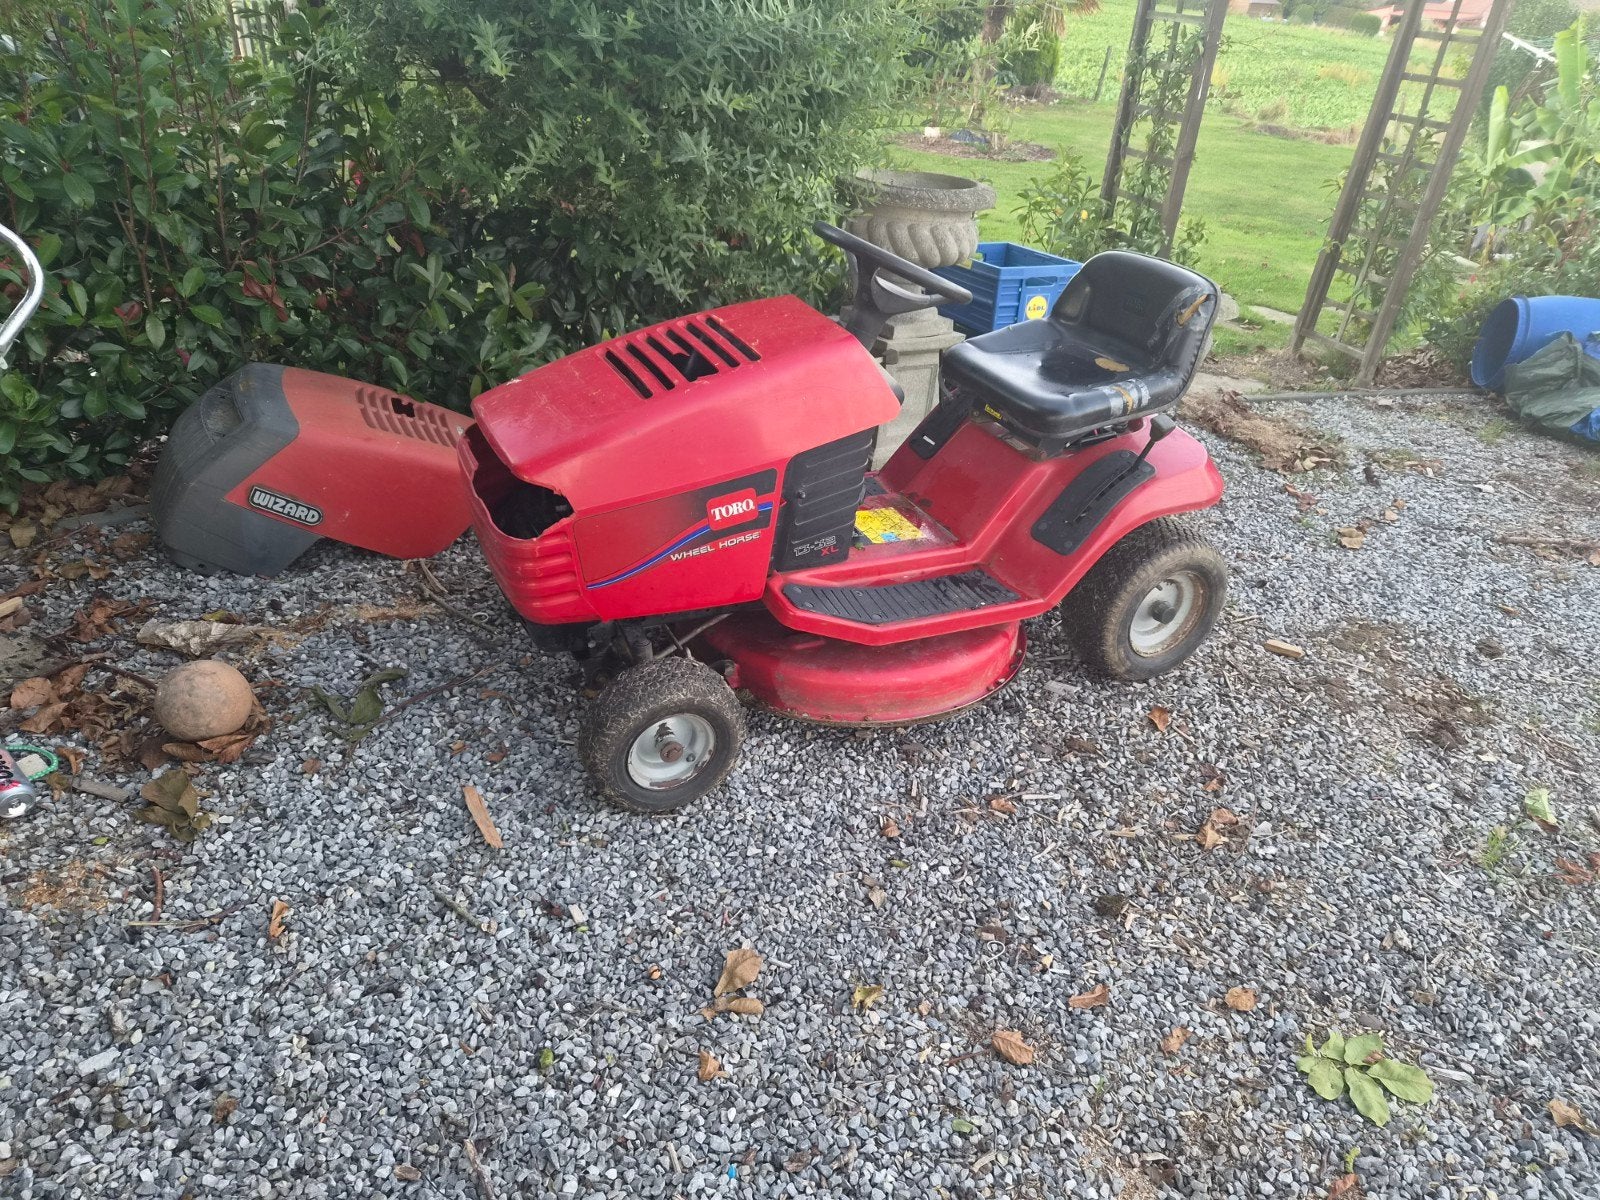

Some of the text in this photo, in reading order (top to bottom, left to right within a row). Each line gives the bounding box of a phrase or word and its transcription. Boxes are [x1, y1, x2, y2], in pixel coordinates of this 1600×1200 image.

[253, 490, 319, 522] WIZARD
[711, 499, 755, 521] TORO
[670, 532, 760, 561] WHEEL HORSE
[821, 545, 839, 557] XL
